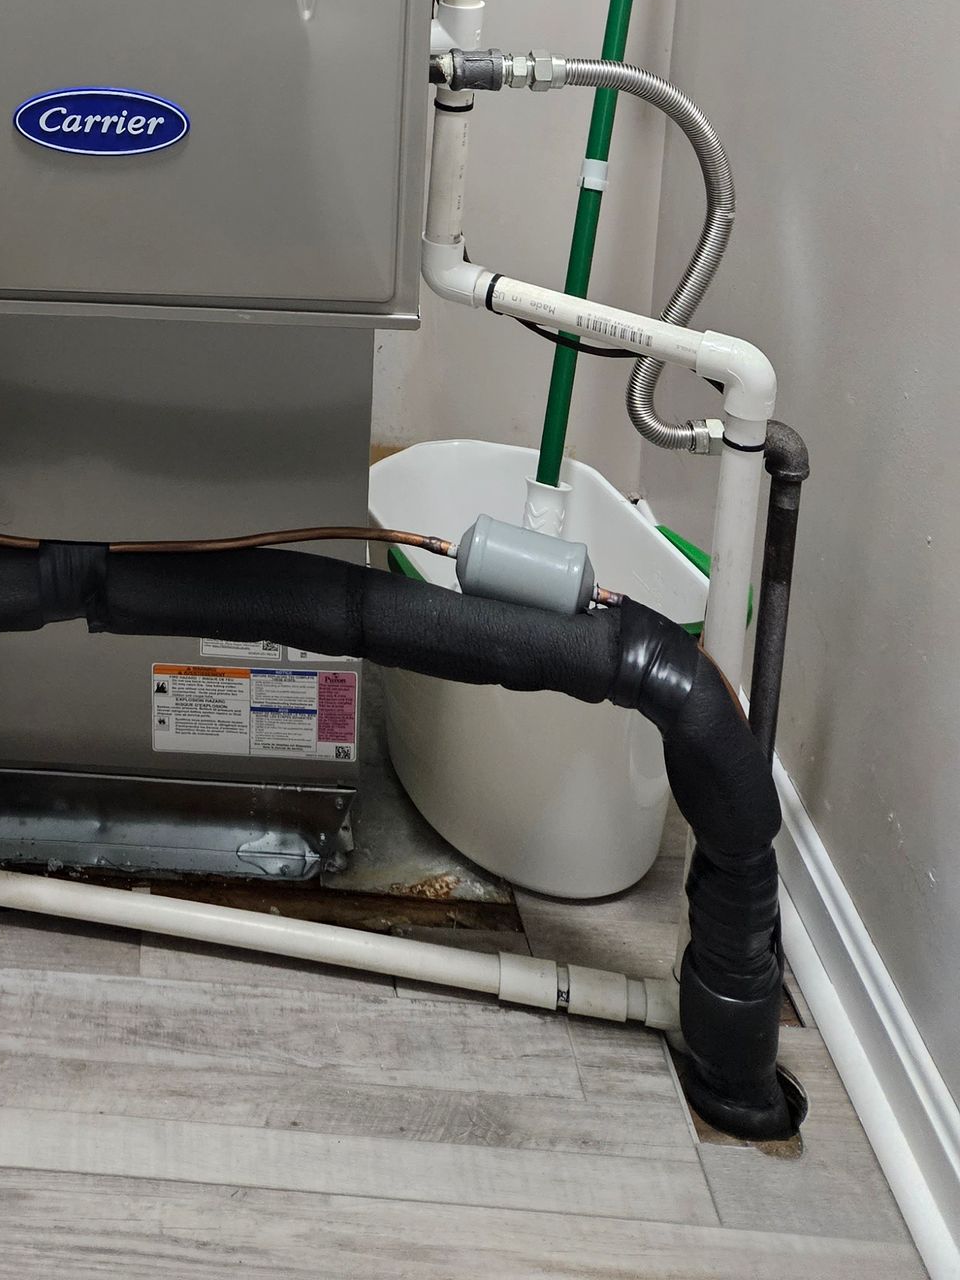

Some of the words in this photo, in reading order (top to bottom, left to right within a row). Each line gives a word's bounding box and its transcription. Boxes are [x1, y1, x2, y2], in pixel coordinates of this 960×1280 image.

[39, 107, 165, 135] Carrier
[511, 295, 521, 303] in
[530, 300, 556, 315] Made
